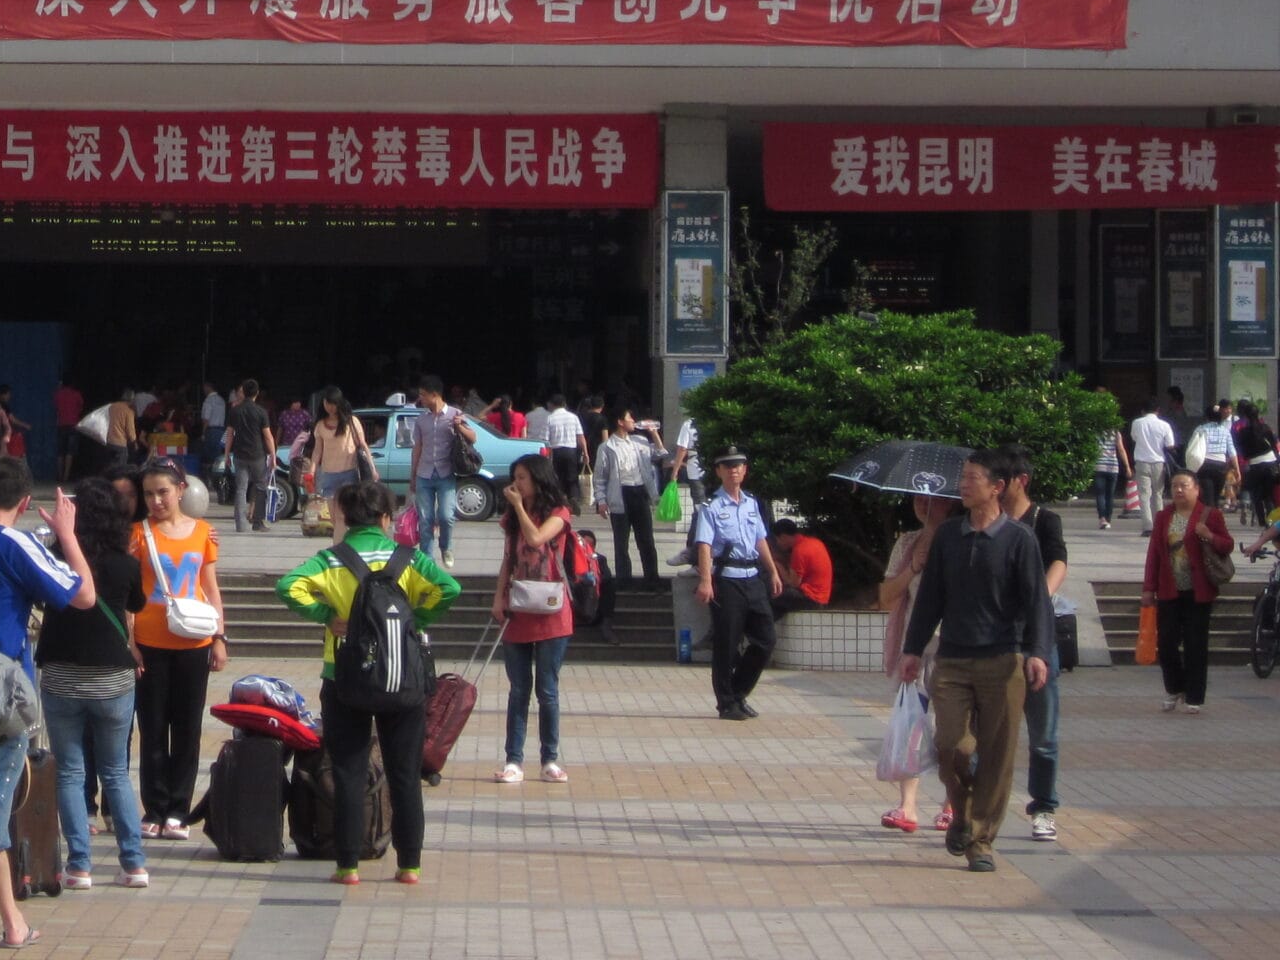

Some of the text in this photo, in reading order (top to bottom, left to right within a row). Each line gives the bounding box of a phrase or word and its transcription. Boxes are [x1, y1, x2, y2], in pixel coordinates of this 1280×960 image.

[66, 125, 626, 189] 深入推进第三轮禁毒人民战争
[831, 136, 994, 196] 爱我昆明
[1052, 137, 1218, 195] 美在春城
